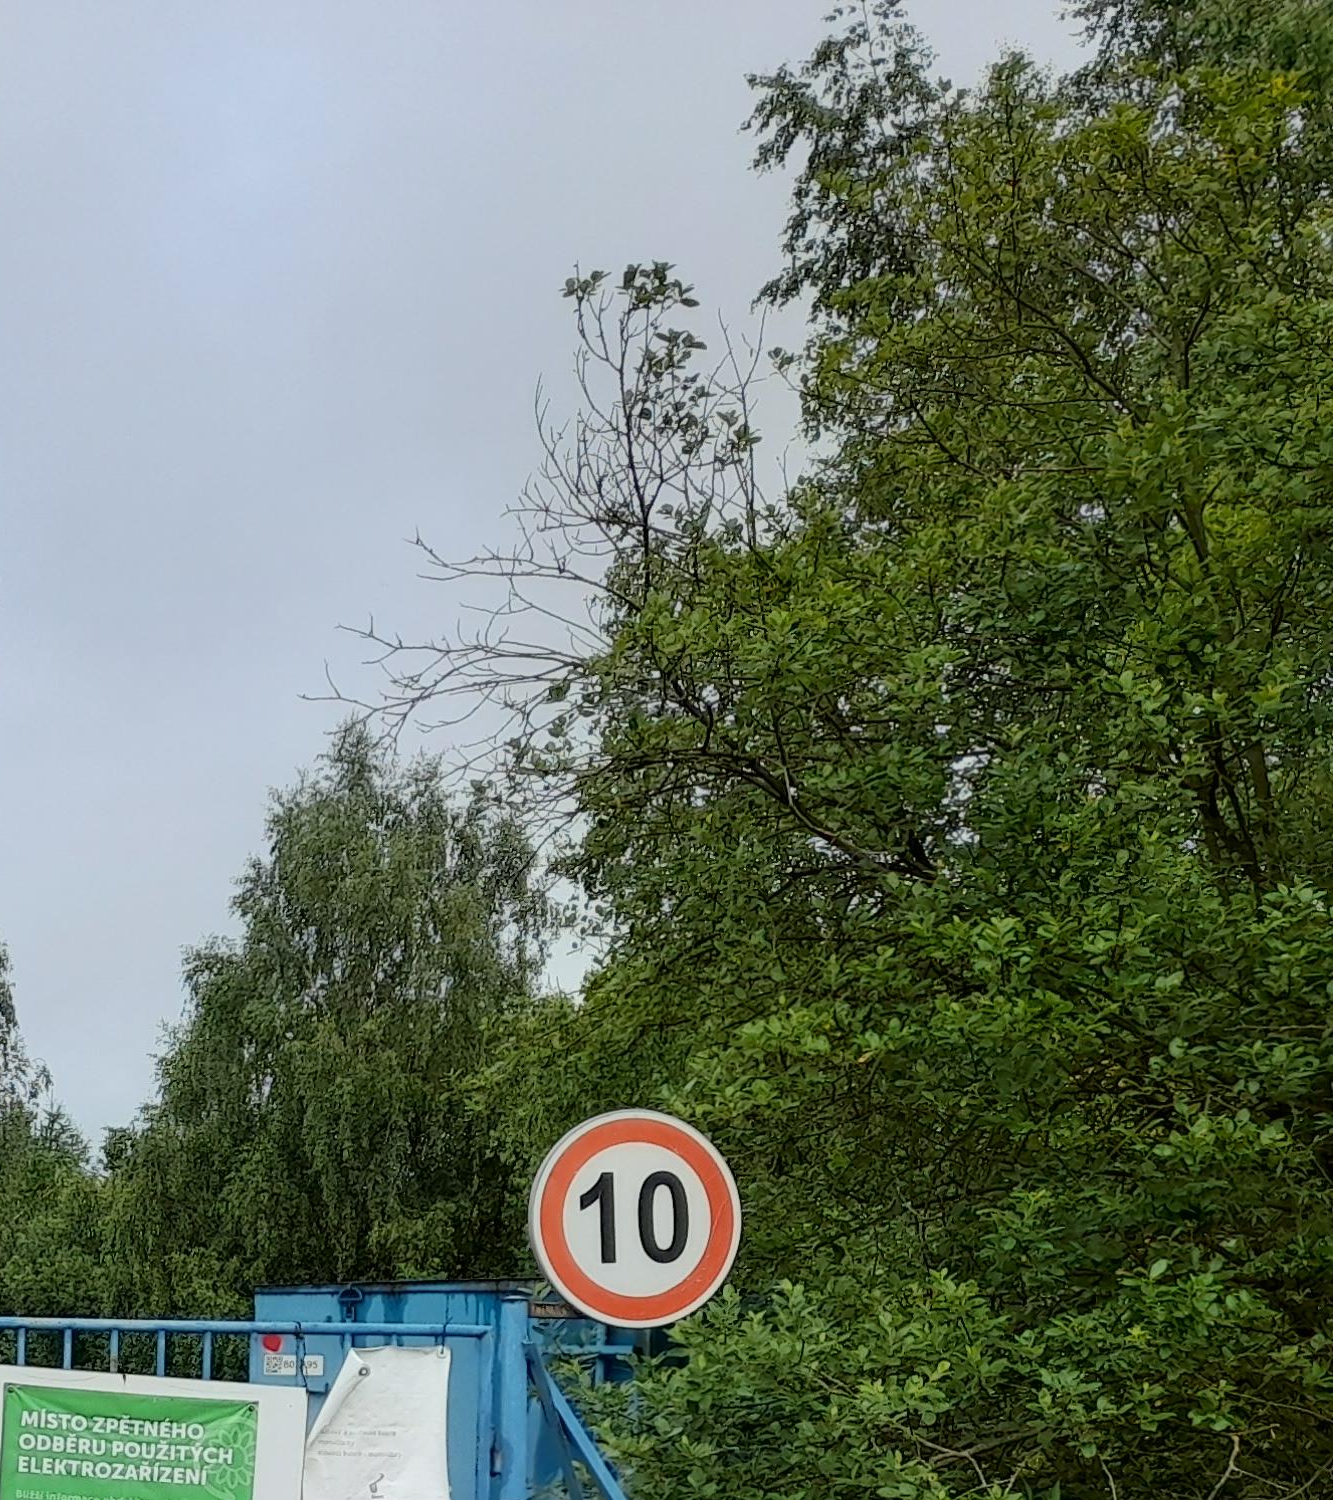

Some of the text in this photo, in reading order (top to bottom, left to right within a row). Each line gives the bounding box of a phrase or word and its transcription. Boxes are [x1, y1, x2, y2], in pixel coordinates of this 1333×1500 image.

[579, 1170, 689, 1263] 10
[21, 1409, 205, 1440] MÍSTO ZPĚTNÉHO
[18, 1433, 233, 1465] ODBĚRU POUŽITÝCH
[17, 1456, 208, 1486] ELEKTROZAŘÍZENÍ
